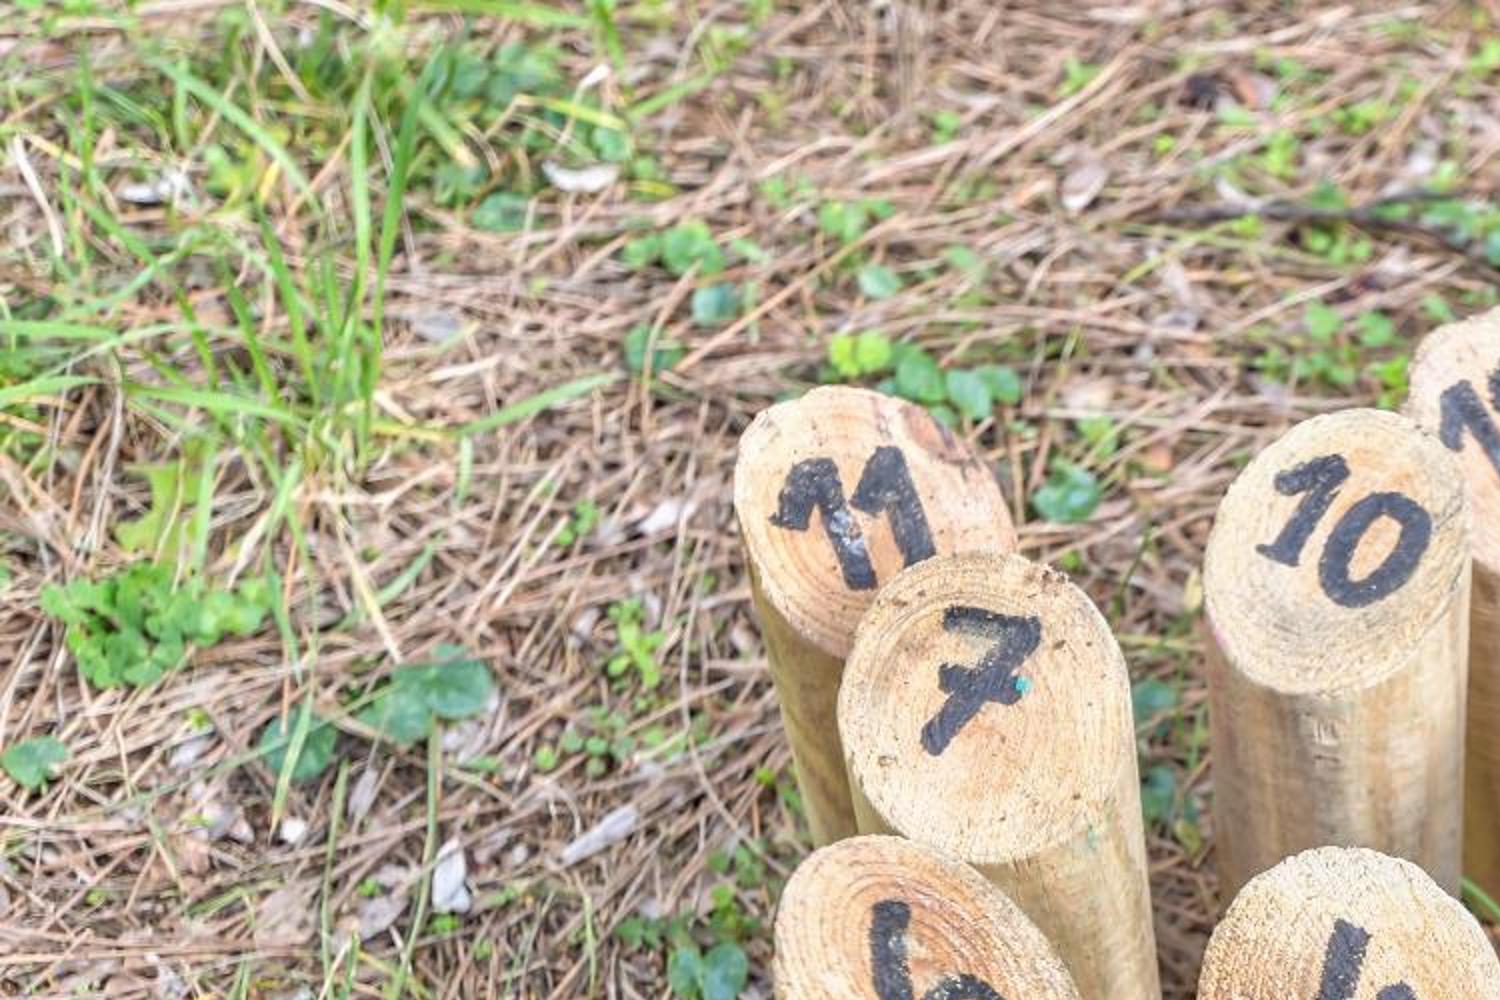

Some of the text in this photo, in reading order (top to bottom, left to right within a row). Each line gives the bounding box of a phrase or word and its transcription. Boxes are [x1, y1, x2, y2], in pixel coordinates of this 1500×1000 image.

[769, 446, 936, 590] 11
[1258, 455, 1431, 606] 10
[921, 606, 1041, 755] 7
